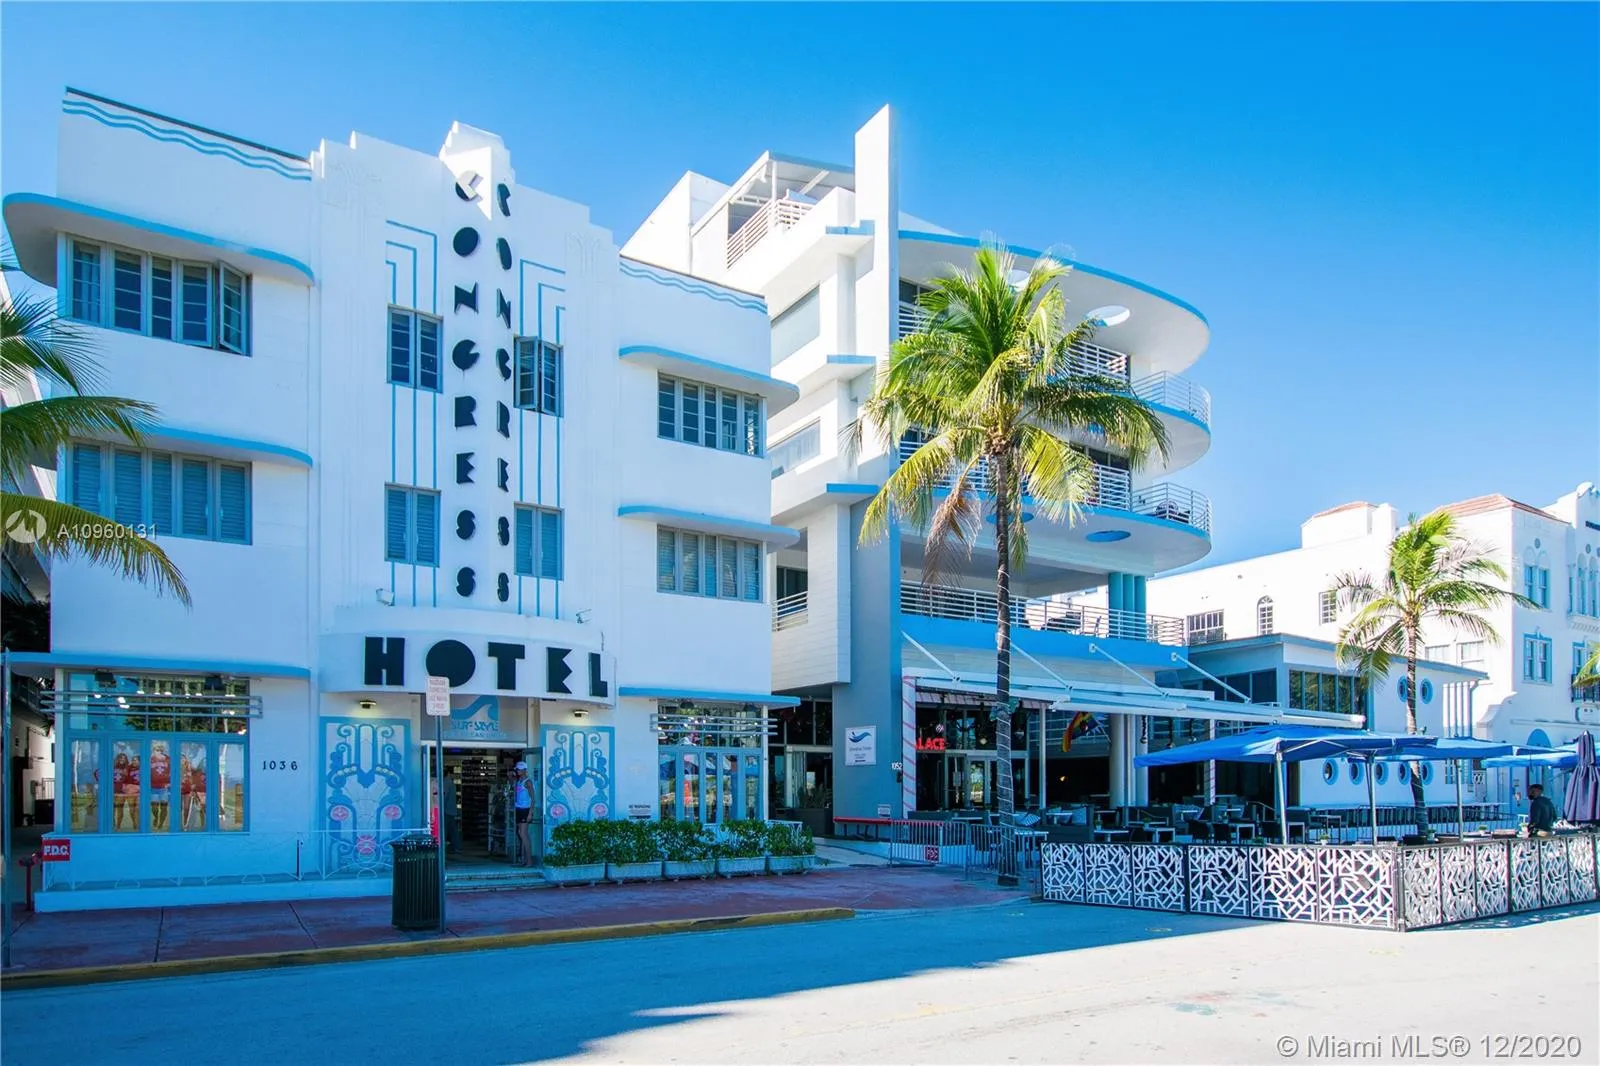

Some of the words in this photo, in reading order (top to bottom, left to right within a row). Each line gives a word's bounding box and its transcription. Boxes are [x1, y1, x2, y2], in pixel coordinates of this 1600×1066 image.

[452, 170, 482, 597] CONGRESS
[496, 183, 512, 602] CONGRESS
[364, 636, 609, 698] HOTEL
[262, 760, 298, 771] 1036
[915, 736, 945, 751] LACE
